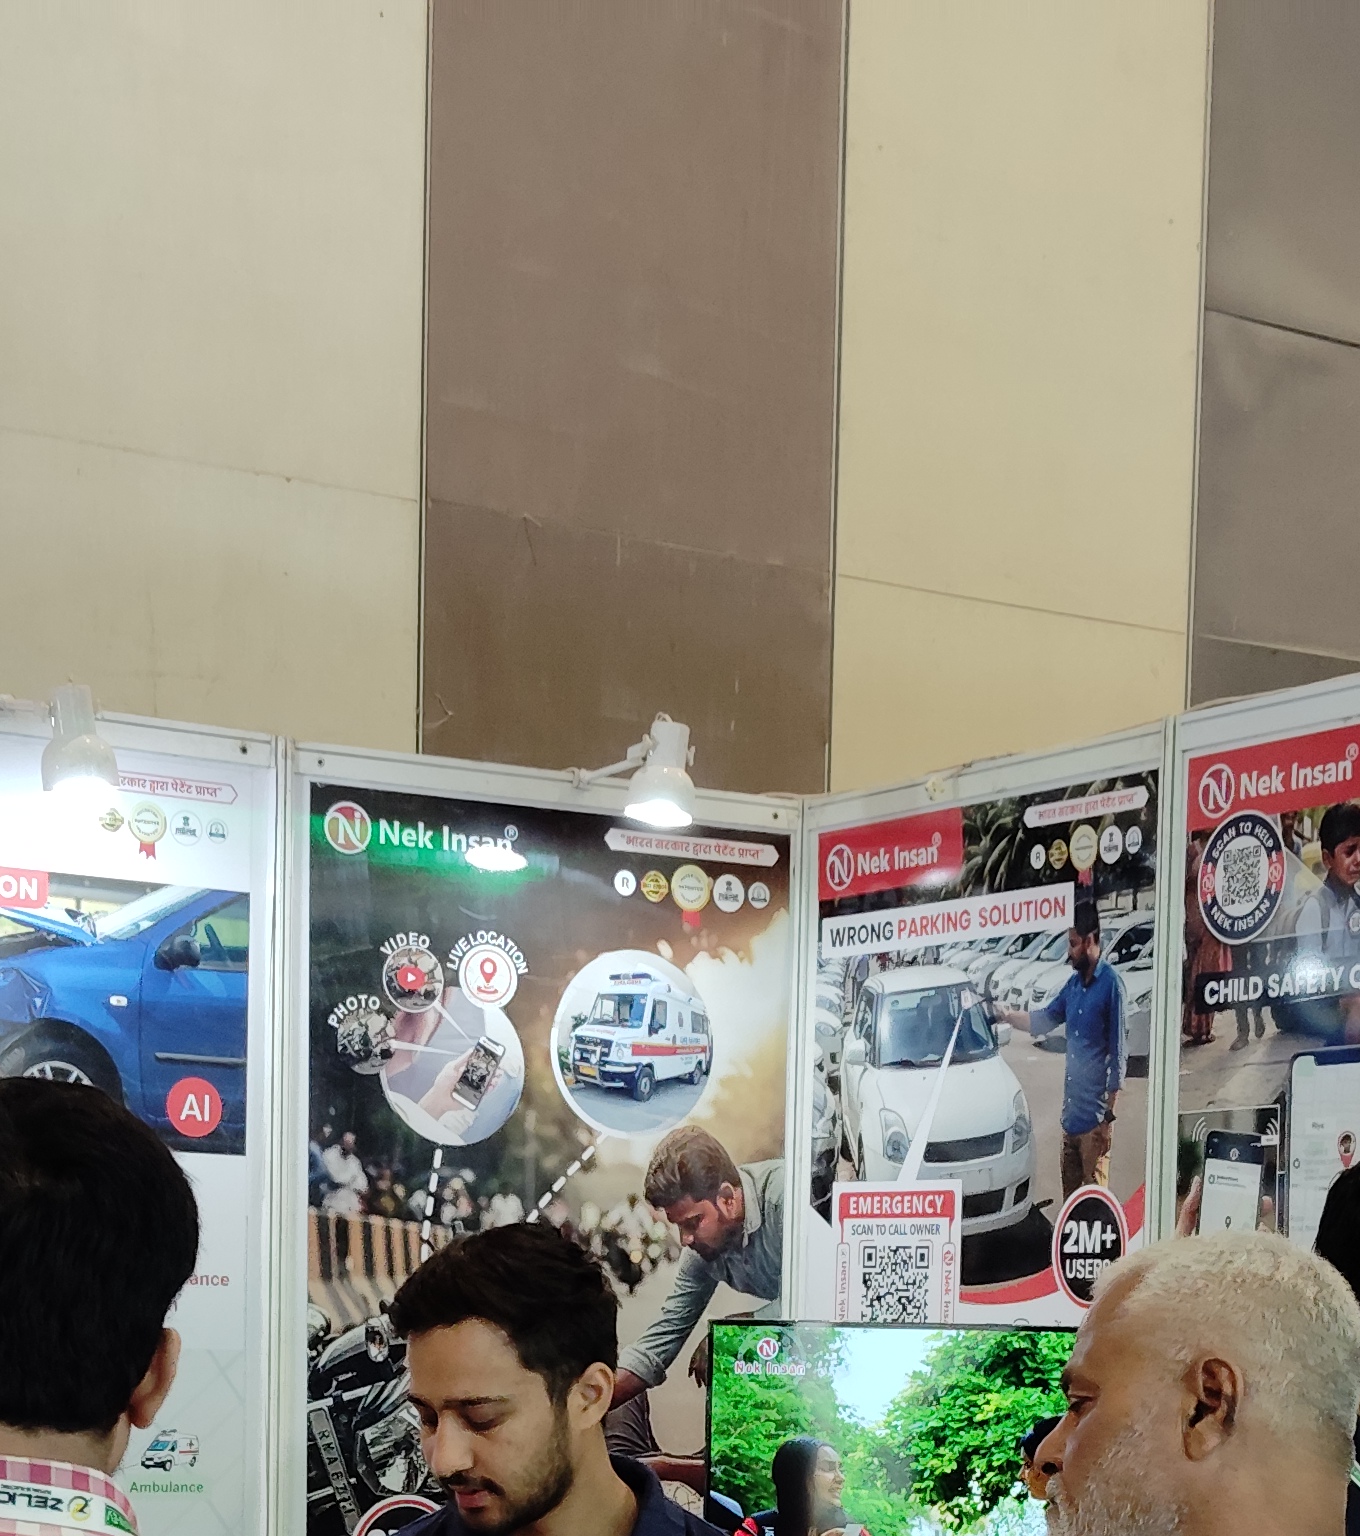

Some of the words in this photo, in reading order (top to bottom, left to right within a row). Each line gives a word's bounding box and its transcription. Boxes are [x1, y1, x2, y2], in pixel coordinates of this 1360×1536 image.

[1239, 768, 1285, 801] Nek
[378, 819, 433, 849] Nek
[1211, 825, 1237, 860] SCAN
[1239, 821, 1253, 834] TO
[1253, 824, 1274, 848] HELP
[856, 848, 892, 878] Nek
[830, 919, 895, 948] WRONG
[897, 907, 972, 941] PARKING
[978, 895, 1067, 929] SOLUTION
[1210, 904, 1232, 931] NEK
[1233, 898, 1271, 932] INSAN
[380, 932, 431, 956] VIDEO
[446, 936, 471, 971] LIVE
[469, 930, 529, 975] LOCATION
[1204, 971, 1263, 1005] CHILD
[1266, 963, 1342, 999] SAFETY
[327, 994, 381, 1029] PHOTO
[180, 1095, 211, 1122] AI
[849, 1194, 944, 1215] EMERGENCY
[851, 1224, 873, 1236] SCAN
[876, 1224, 886, 1236] TO
[888, 1223, 907, 1236] CALL
[910, 1224, 941, 1236] OWNER
[1062, 1220, 1118, 1254] 2M+
[130, 1480, 204, 1495] Ambulance
